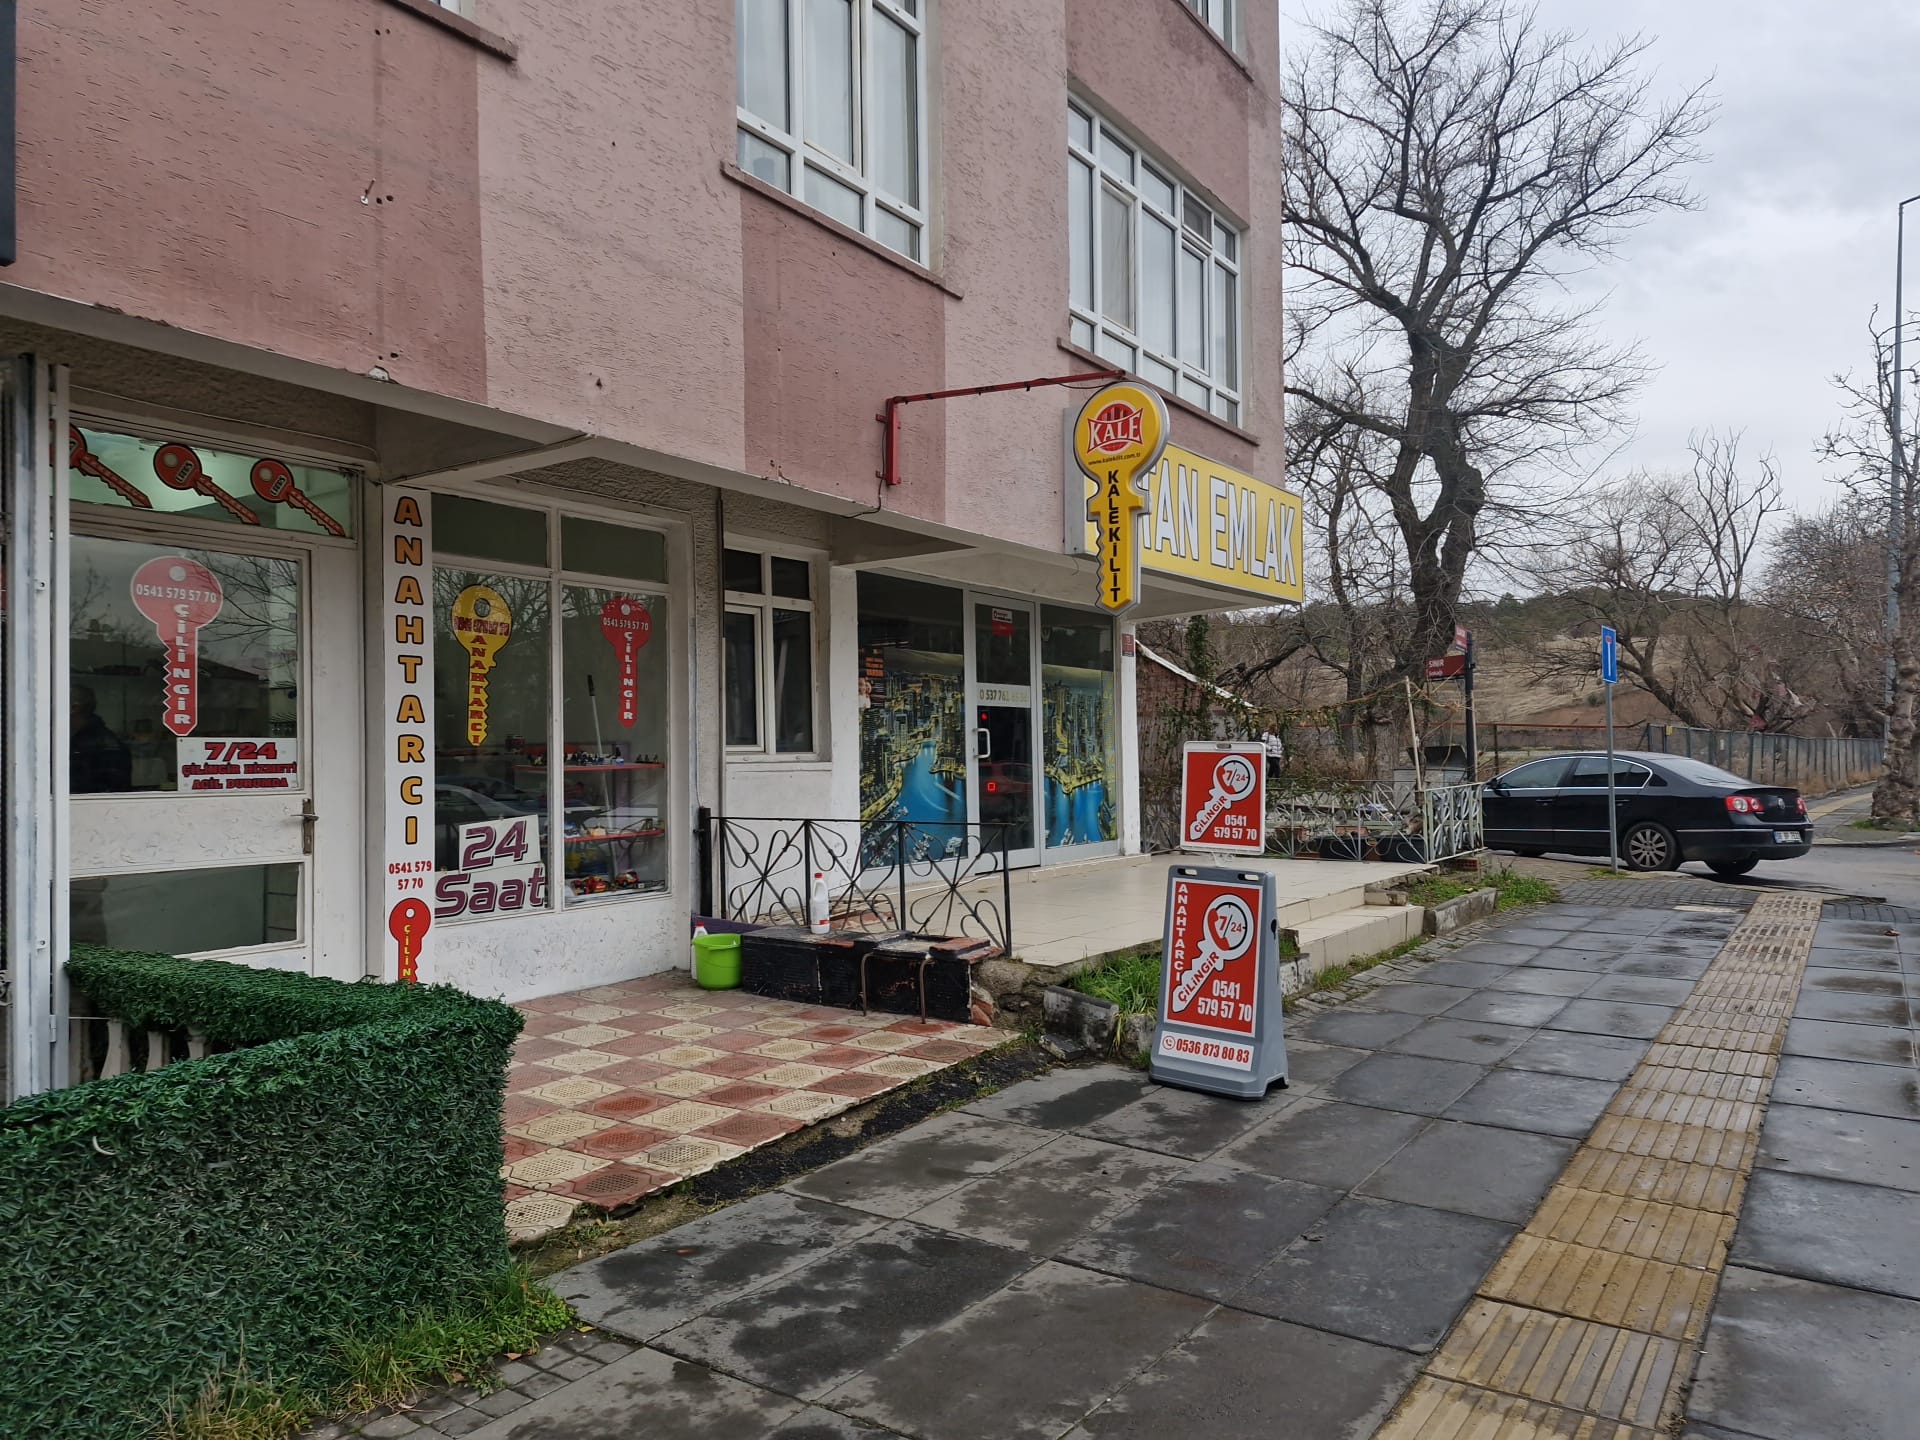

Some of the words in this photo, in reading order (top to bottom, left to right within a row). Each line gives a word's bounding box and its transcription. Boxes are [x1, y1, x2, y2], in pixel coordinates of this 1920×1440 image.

[1090, 411, 1140, 449] KALE
[1209, 475, 1296, 586] EMLAK
[136, 584, 163, 597] 0541
[167, 587, 185, 600] 579
[189, 590, 200, 601] 57
[204, 591, 216, 603] 70
[603, 617, 618, 627] 0541
[641, 622, 649, 631] 70
[394, 496, 425, 845] ANAHTARCI
[469, 635, 488, 744] ANAHTARCI
[204, 742, 277, 762] 7/24
[1224, 814, 1247, 826] 0541
[462, 820, 528, 870] 24
[1214, 827, 1230, 838] 579
[1232, 828, 1243, 839] 57
[1247, 828, 1257, 840] 70
[389, 862, 412, 874] 0541
[415, 860, 432, 873] 579
[398, 878, 409, 890] 57
[412, 877, 423, 889] 70
[435, 867, 546, 917] Saat
[1174, 883, 1188, 982] ANAHTARCI
[1212, 979, 1241, 1000] 0541
[1197, 997, 1218, 1017] 579
[1220, 1001, 1234, 1019] 57
[1238, 1003, 1252, 1022] 70
[1176, 1038, 1200, 1054] 0536
[1202, 1043, 1218, 1058] 873
[1221, 1046, 1234, 1061] 80
[1236, 1049, 1250, 1063] 83
